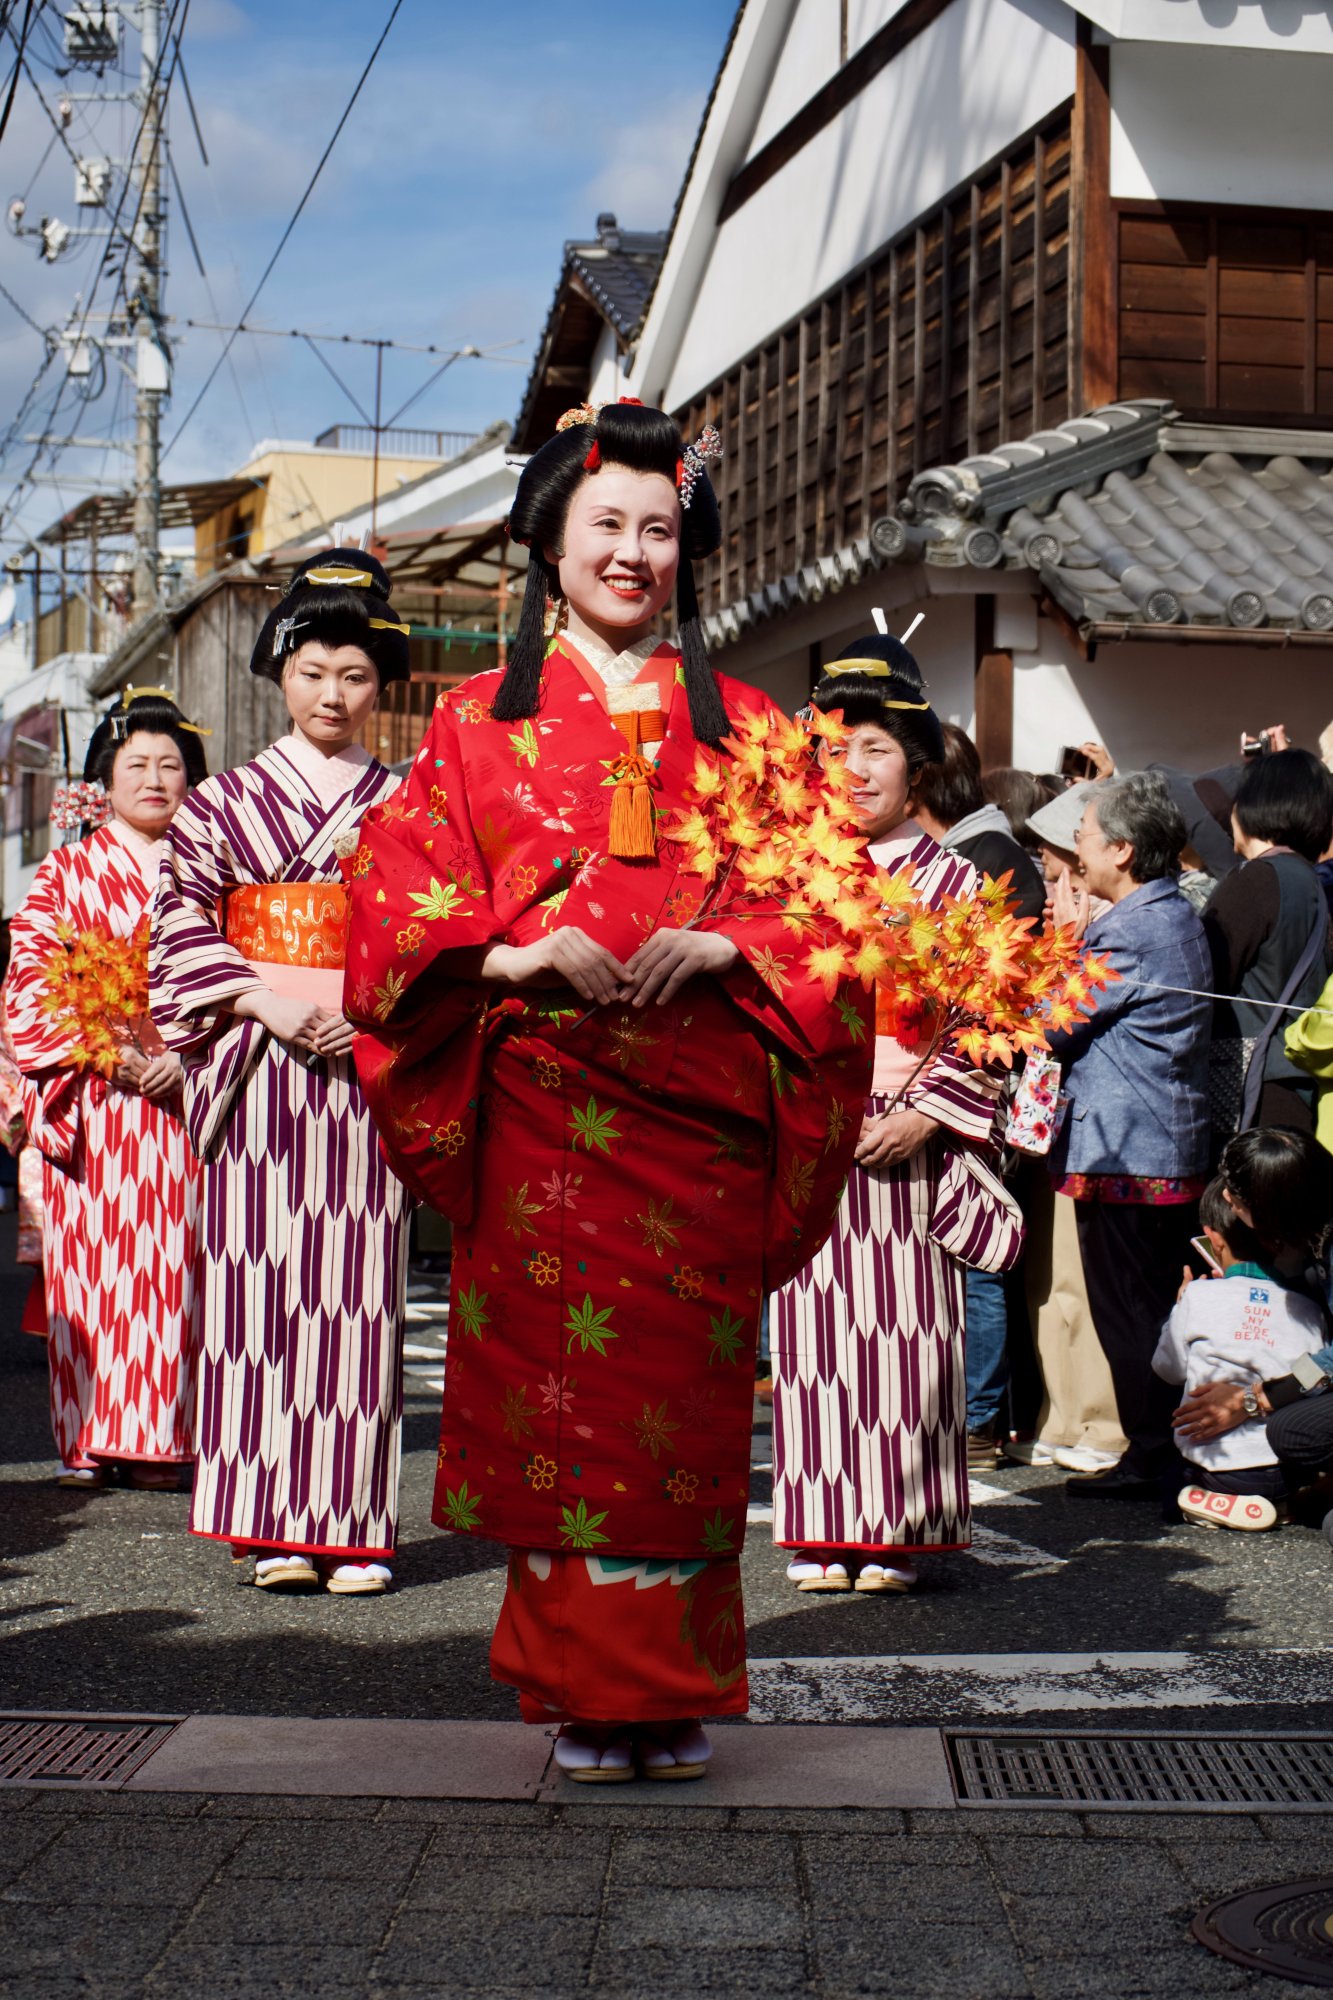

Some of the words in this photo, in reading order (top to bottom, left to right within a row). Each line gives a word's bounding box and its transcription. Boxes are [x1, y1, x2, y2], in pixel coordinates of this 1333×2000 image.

[1244, 1305, 1271, 1317] SUN
[1248, 1315, 1264, 1326] NY
[1241, 1322, 1269, 1337] SIDE
